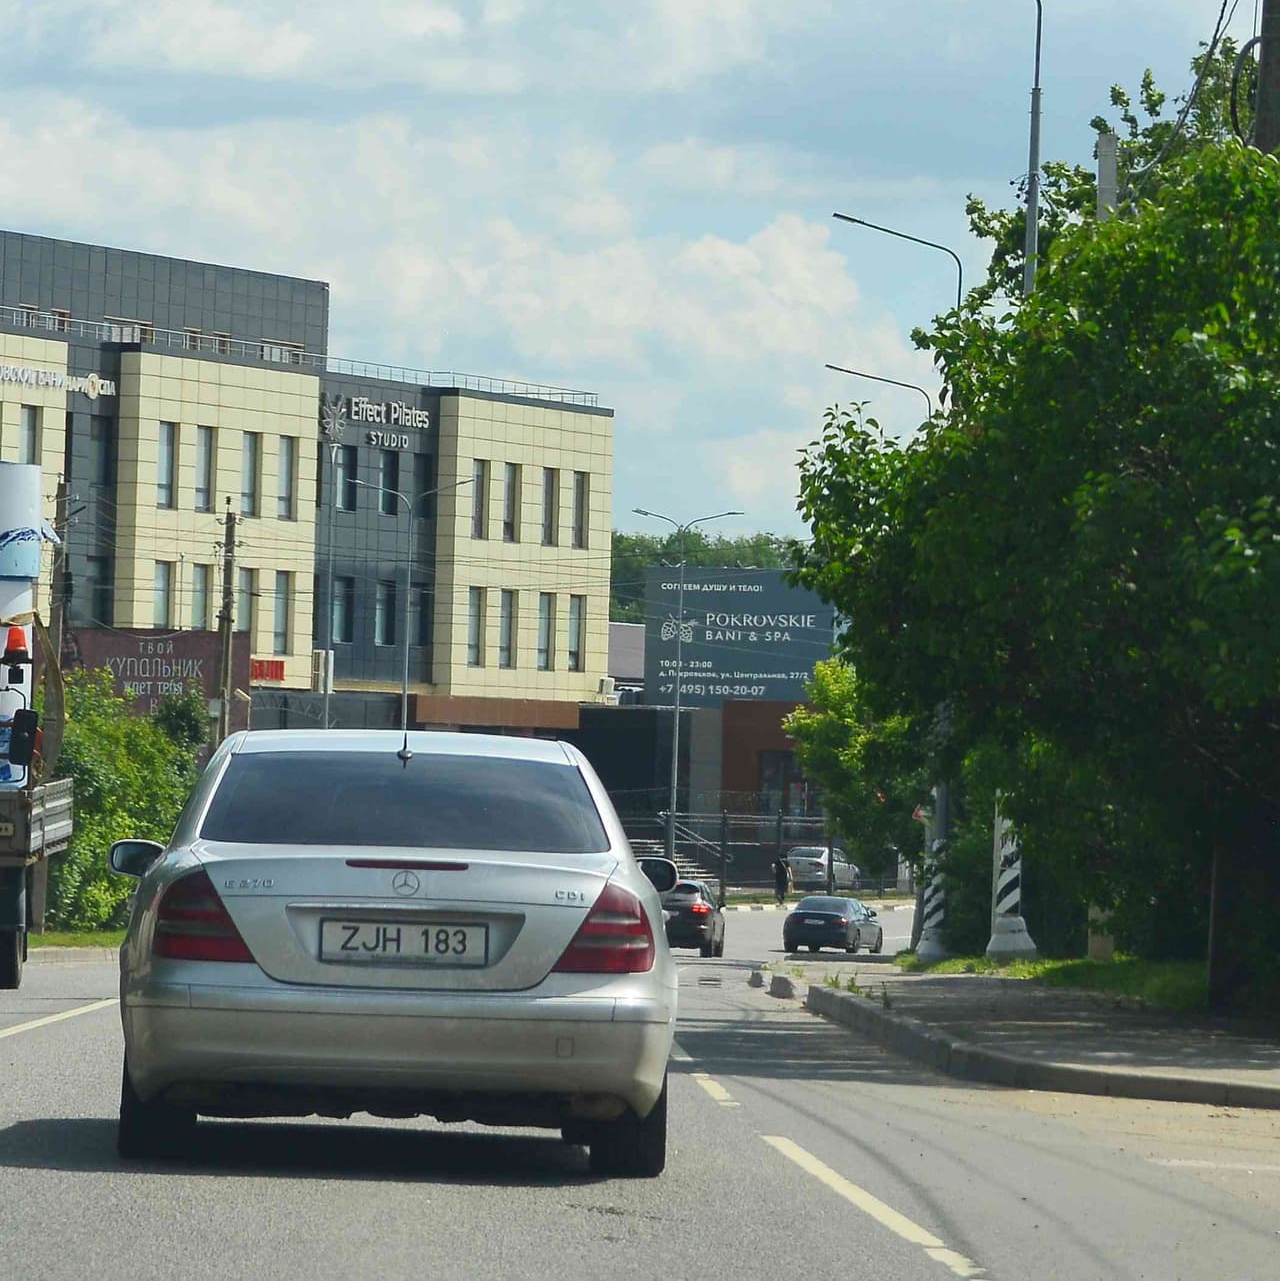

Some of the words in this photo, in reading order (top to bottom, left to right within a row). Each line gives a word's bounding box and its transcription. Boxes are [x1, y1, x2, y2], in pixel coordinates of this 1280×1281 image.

[38, 370, 65, 390] БАНИ
[351, 397, 387, 423] Effect
[391, 400, 430, 429] Pilates
[370, 431, 409, 448] STUDIO
[706, 612, 816, 628] POKROVSKIE
[705, 630, 742, 641] BANI
[749, 631, 758, 641] &
[765, 631, 791, 641] SPA
[139, 640, 174, 654] ТВОЙ
[659, 684, 673, 693] +7
[677, 684, 705, 695] 495)
[708, 685, 765, 695] 150-20-07
[340, 925, 402, 953] ZJH
[421, 927, 467, 955] 183
